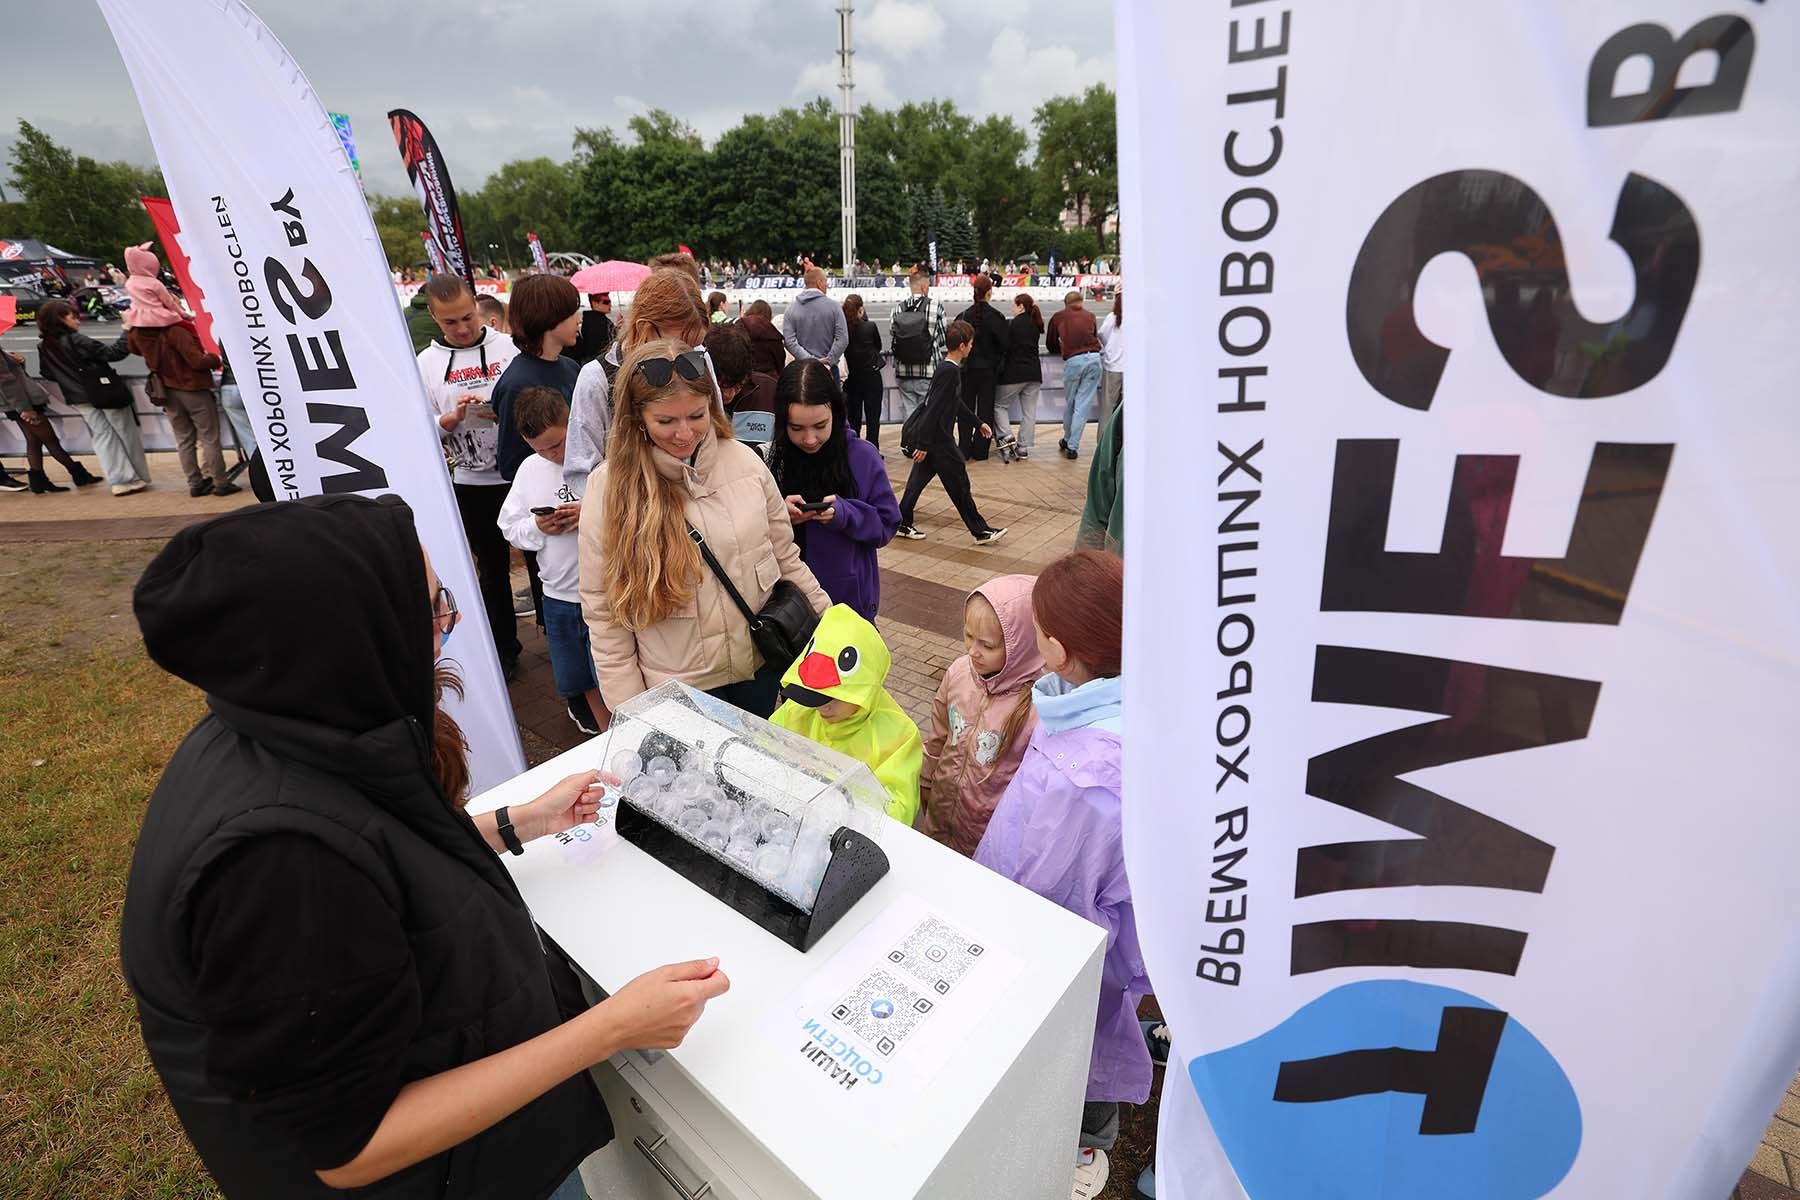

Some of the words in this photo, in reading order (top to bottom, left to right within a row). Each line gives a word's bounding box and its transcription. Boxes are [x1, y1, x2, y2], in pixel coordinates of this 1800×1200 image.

[745, 277, 760, 288] 90
[761, 277, 785, 288] ЛЕТ
[555, 832, 574, 845] НА
[800, 1040, 859, 1092] НАШИ
[802, 1018, 884, 1086] СОЦСЕТИ
